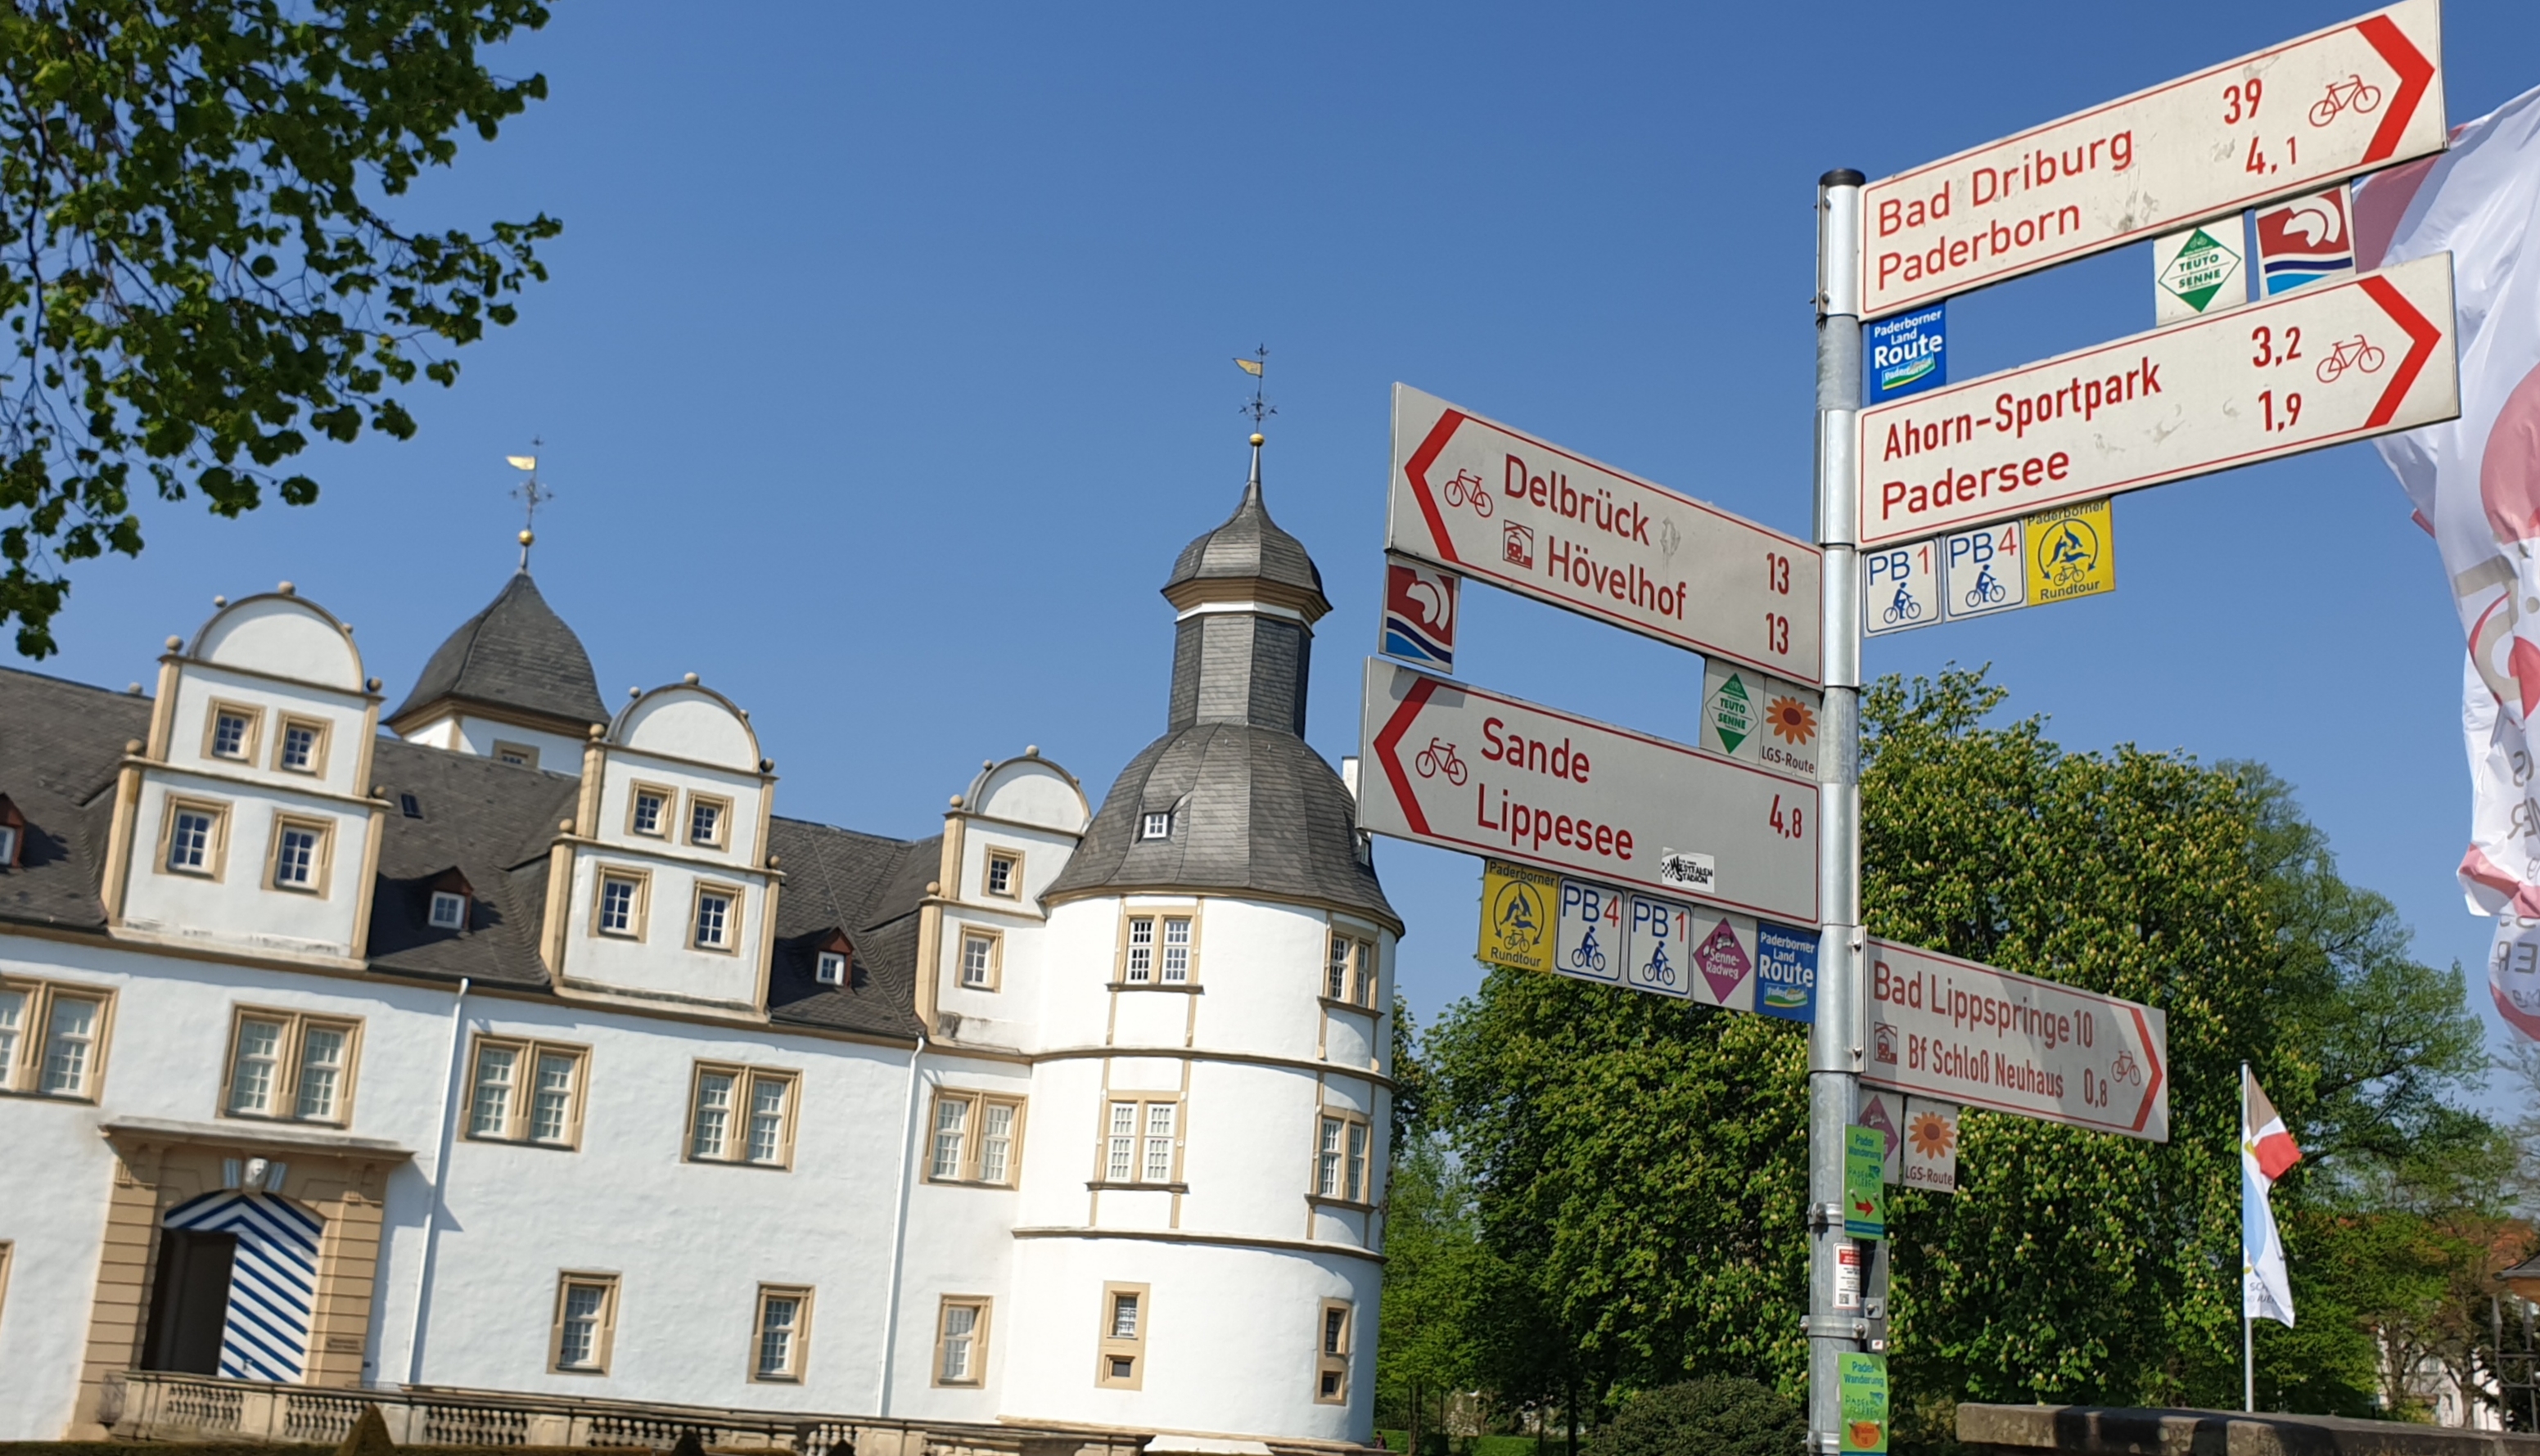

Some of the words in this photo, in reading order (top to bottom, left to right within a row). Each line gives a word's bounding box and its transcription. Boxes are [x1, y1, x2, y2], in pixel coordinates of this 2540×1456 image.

[1878, 181, 1951, 239] Bad
[1972, 130, 2133, 208] Driburg
[2222, 77, 2264, 126] 39
[1878, 205, 2081, 291] Paderborn
[2245, 136, 2298, 176] 4,1
[2178, 254, 2219, 273] TEUTO
[2178, 268, 2221, 289] SENNE
[1874, 309, 1942, 338] Paderborner
[1890, 327, 1917, 345] Land
[1874, 332, 1943, 369] Route
[1884, 356, 2162, 462] Ahorn-Sportpark
[2251, 325, 2302, 369] 3,2
[1881, 450, 2071, 521] Padersee
[2258, 390, 2303, 433] 1,9
[1505, 454, 1650, 546] Delbrück
[1766, 552, 1790, 596] 13
[2027, 501, 2106, 527] Paderborner
[1949, 532, 1994, 569] PB
[1997, 526, 2018, 557] 4
[1869, 550, 1911, 586] PB
[1916, 546, 1929, 575] 1
[1548, 536, 1687, 620] Hövelhof
[1766, 612, 1789, 656] 13
[2040, 580, 2100, 601] Rundtour
[1719, 697, 1746, 714] TEUTO
[1717, 712, 1746, 730] SENNE
[1761, 745, 1815, 774] LGS-Route
[1482, 717, 1590, 783] Sande
[1769, 794, 1802, 839] 4,8
[1477, 783, 1635, 862] Lippesee
[1489, 861, 1556, 887] Paderborner
[1562, 884, 1600, 922] PB
[1603, 895, 1619, 928] 4
[1632, 900, 1669, 938] PB
[1675, 911, 1685, 943] 1
[1491, 946, 1542, 968] Rundtour
[1708, 948, 1740, 965] Senne-
[1760, 931, 1816, 954] Paderborner
[1773, 947, 1795, 963] Land
[1705, 962, 1739, 980] Radweg
[1759, 953, 1814, 988] Route
[1874, 959, 1922, 1010] Bad
[1931, 973, 2070, 1050] Lippspringe
[2074, 1008, 2094, 1048] 10
[1908, 1033, 1928, 1072] Bf
[1932, 1039, 1991, 1084] Schloß
[1995, 1051, 2064, 1099] Neuhaus
[2083, 1067, 2108, 1109] 0,8
[1905, 1165, 1954, 1186] LGS-Route
[1843, 1373, 1884, 1388] Wanderung
[1852, 1360, 1875, 1373] Pader
